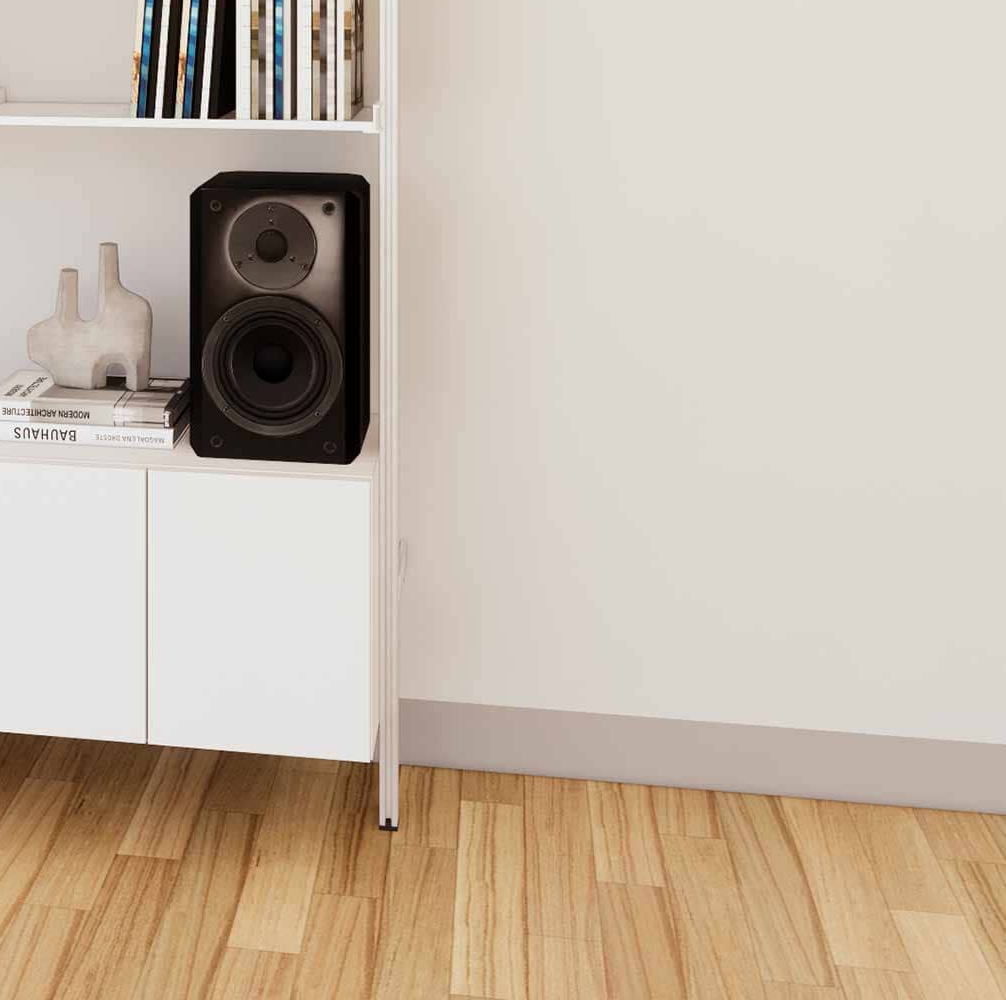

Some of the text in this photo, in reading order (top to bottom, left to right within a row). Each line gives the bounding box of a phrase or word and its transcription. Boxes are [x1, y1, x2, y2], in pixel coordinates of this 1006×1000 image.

[2, 407, 90, 420] MODERN ARCHITECTURE
[14, 427, 76, 442] BAUHAUS
